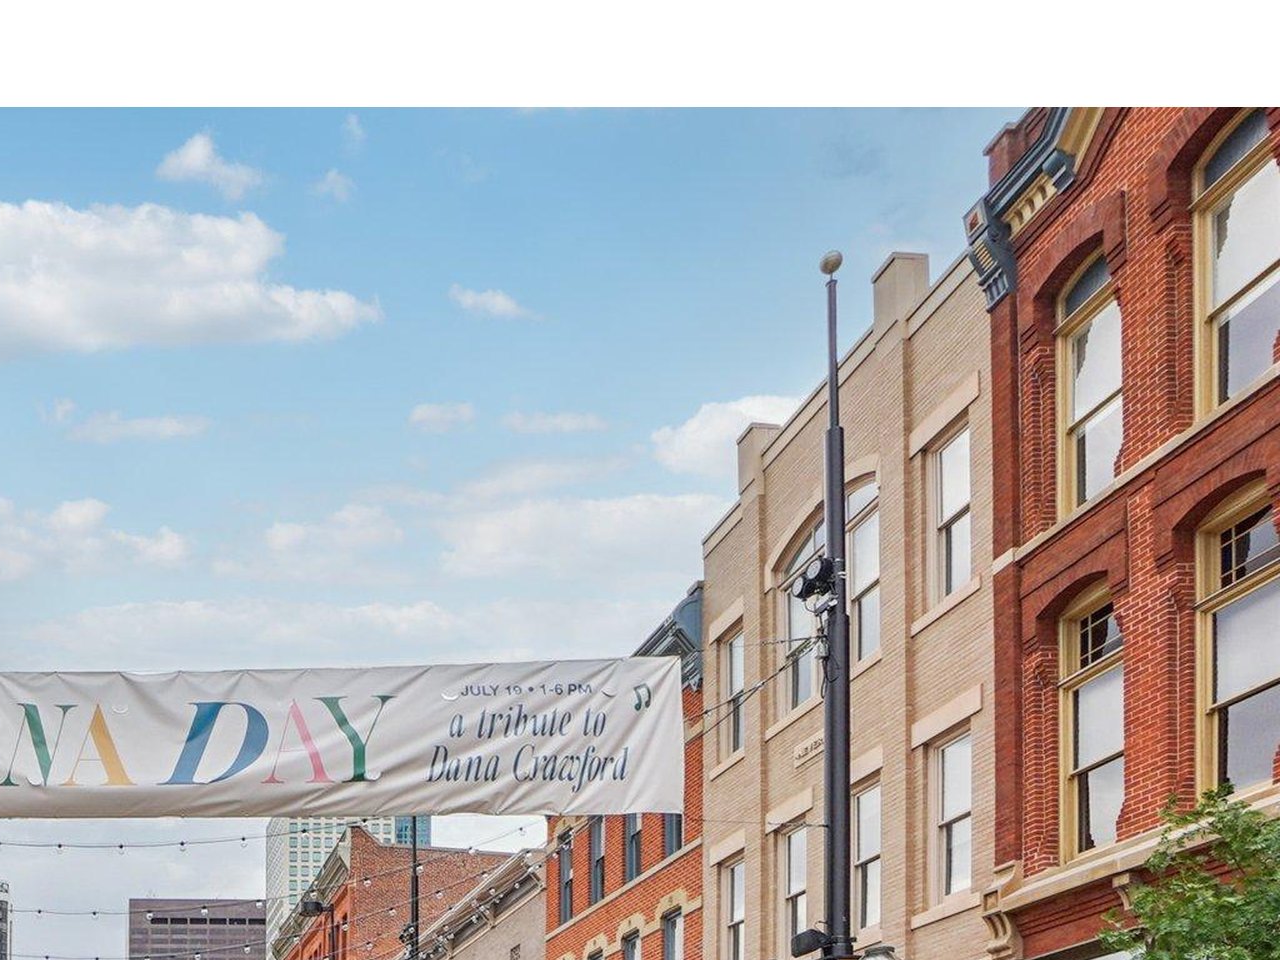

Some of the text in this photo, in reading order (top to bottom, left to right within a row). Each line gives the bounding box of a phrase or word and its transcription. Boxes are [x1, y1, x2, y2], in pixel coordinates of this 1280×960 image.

[461, 684, 499, 697] JULY
[568, 683, 593, 695] PM
[156, 694, 398, 786] DAY
[449, 703, 607, 739] a tribute to
[425, 743, 629, 794] Dana Crawford
